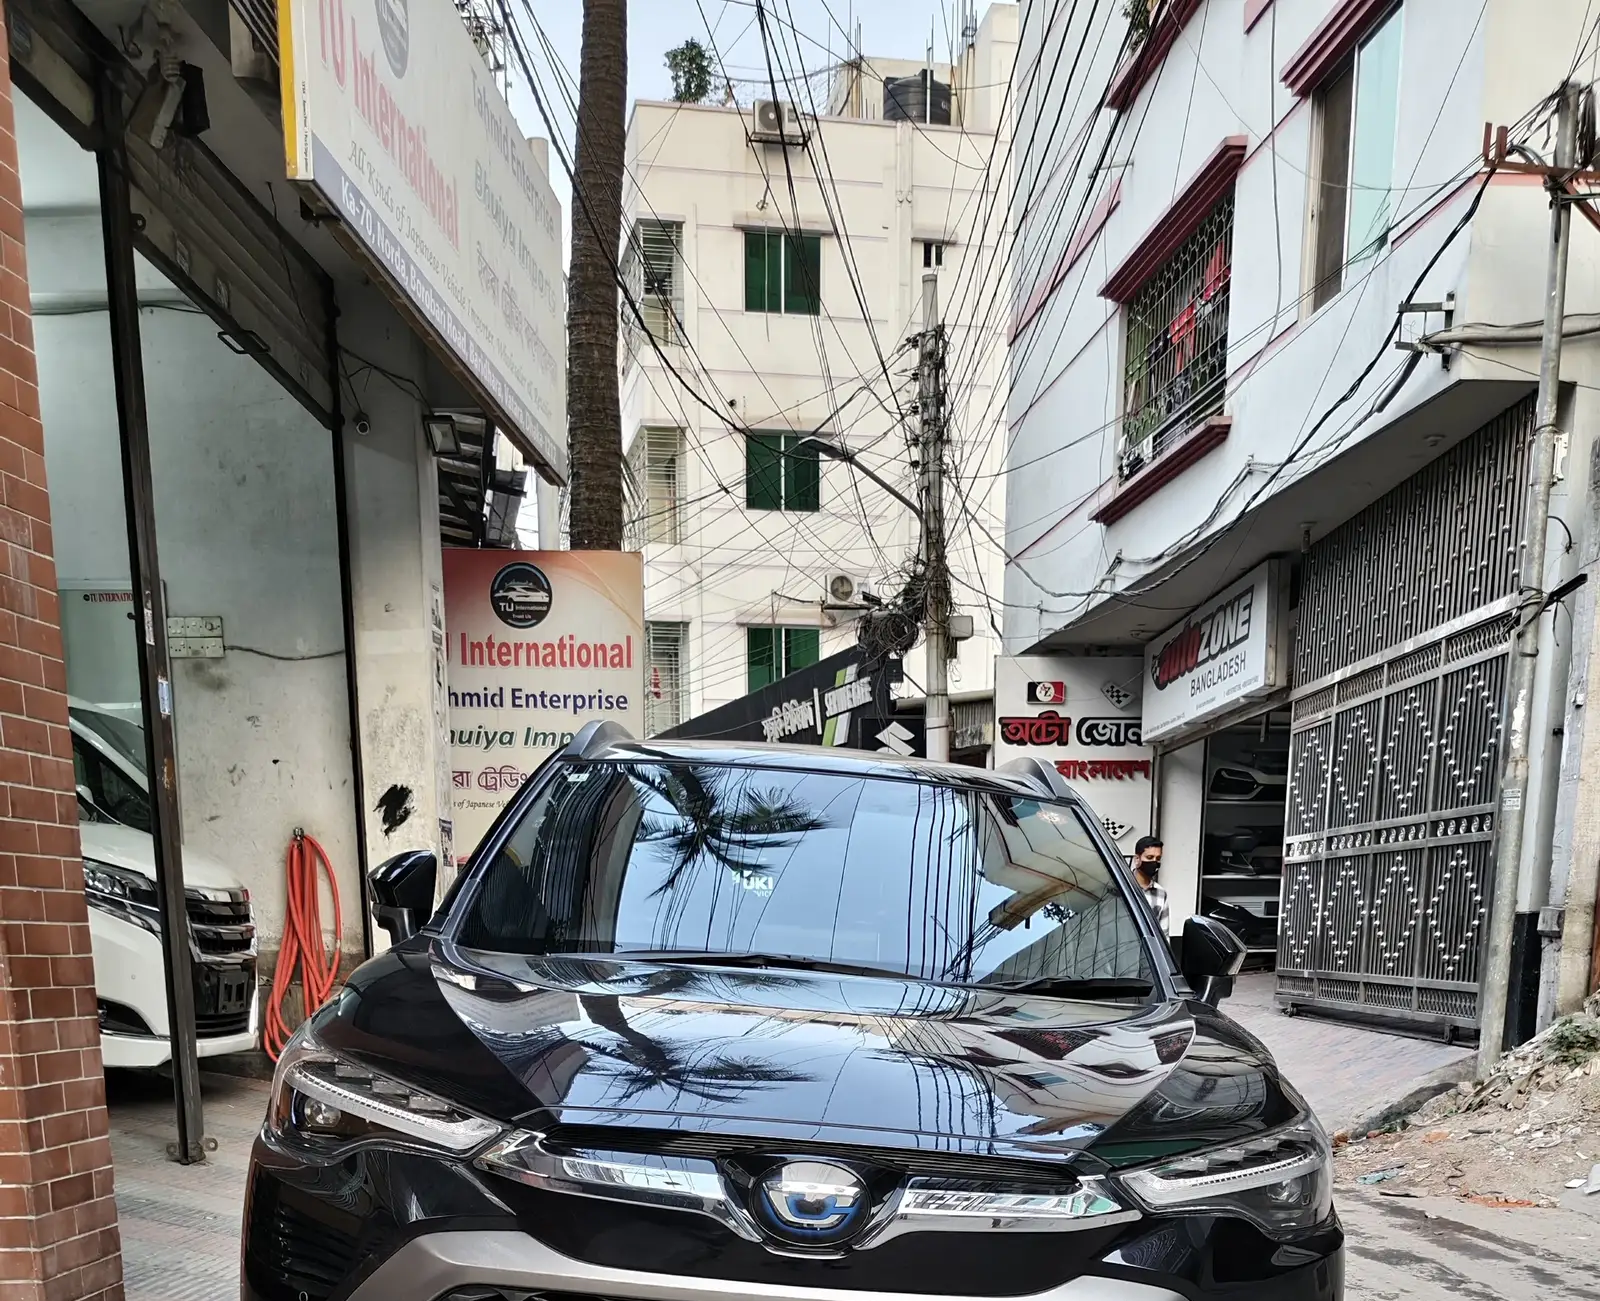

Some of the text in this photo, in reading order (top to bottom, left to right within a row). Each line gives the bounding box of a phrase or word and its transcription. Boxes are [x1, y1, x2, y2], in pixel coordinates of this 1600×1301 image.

[351, 15, 459, 250] International
[471, 63, 555, 240] Tahmid Enterprise
[342, 176, 375, 243] Ka-70,
[377, 221, 408, 285] Norda,
[348, 140, 366, 175] All
[367, 162, 393, 213] Kinds
[396, 206, 406, 231] of
[406, 216, 439, 274] Japanese
[441, 264, 465, 309] Vehicle
[499, 603, 514, 611] TU
[461, 633, 632, 668] International
[1190, 650, 1247, 697] BANGLADESH
[511, 688, 628, 715] Enterprise
[999, 711, 1071, 745] অটো
[1055, 760, 1151, 781] বাংলাদেশ
[457, 800, 466, 809] of
[466, 800, 495, 810] Japanese
